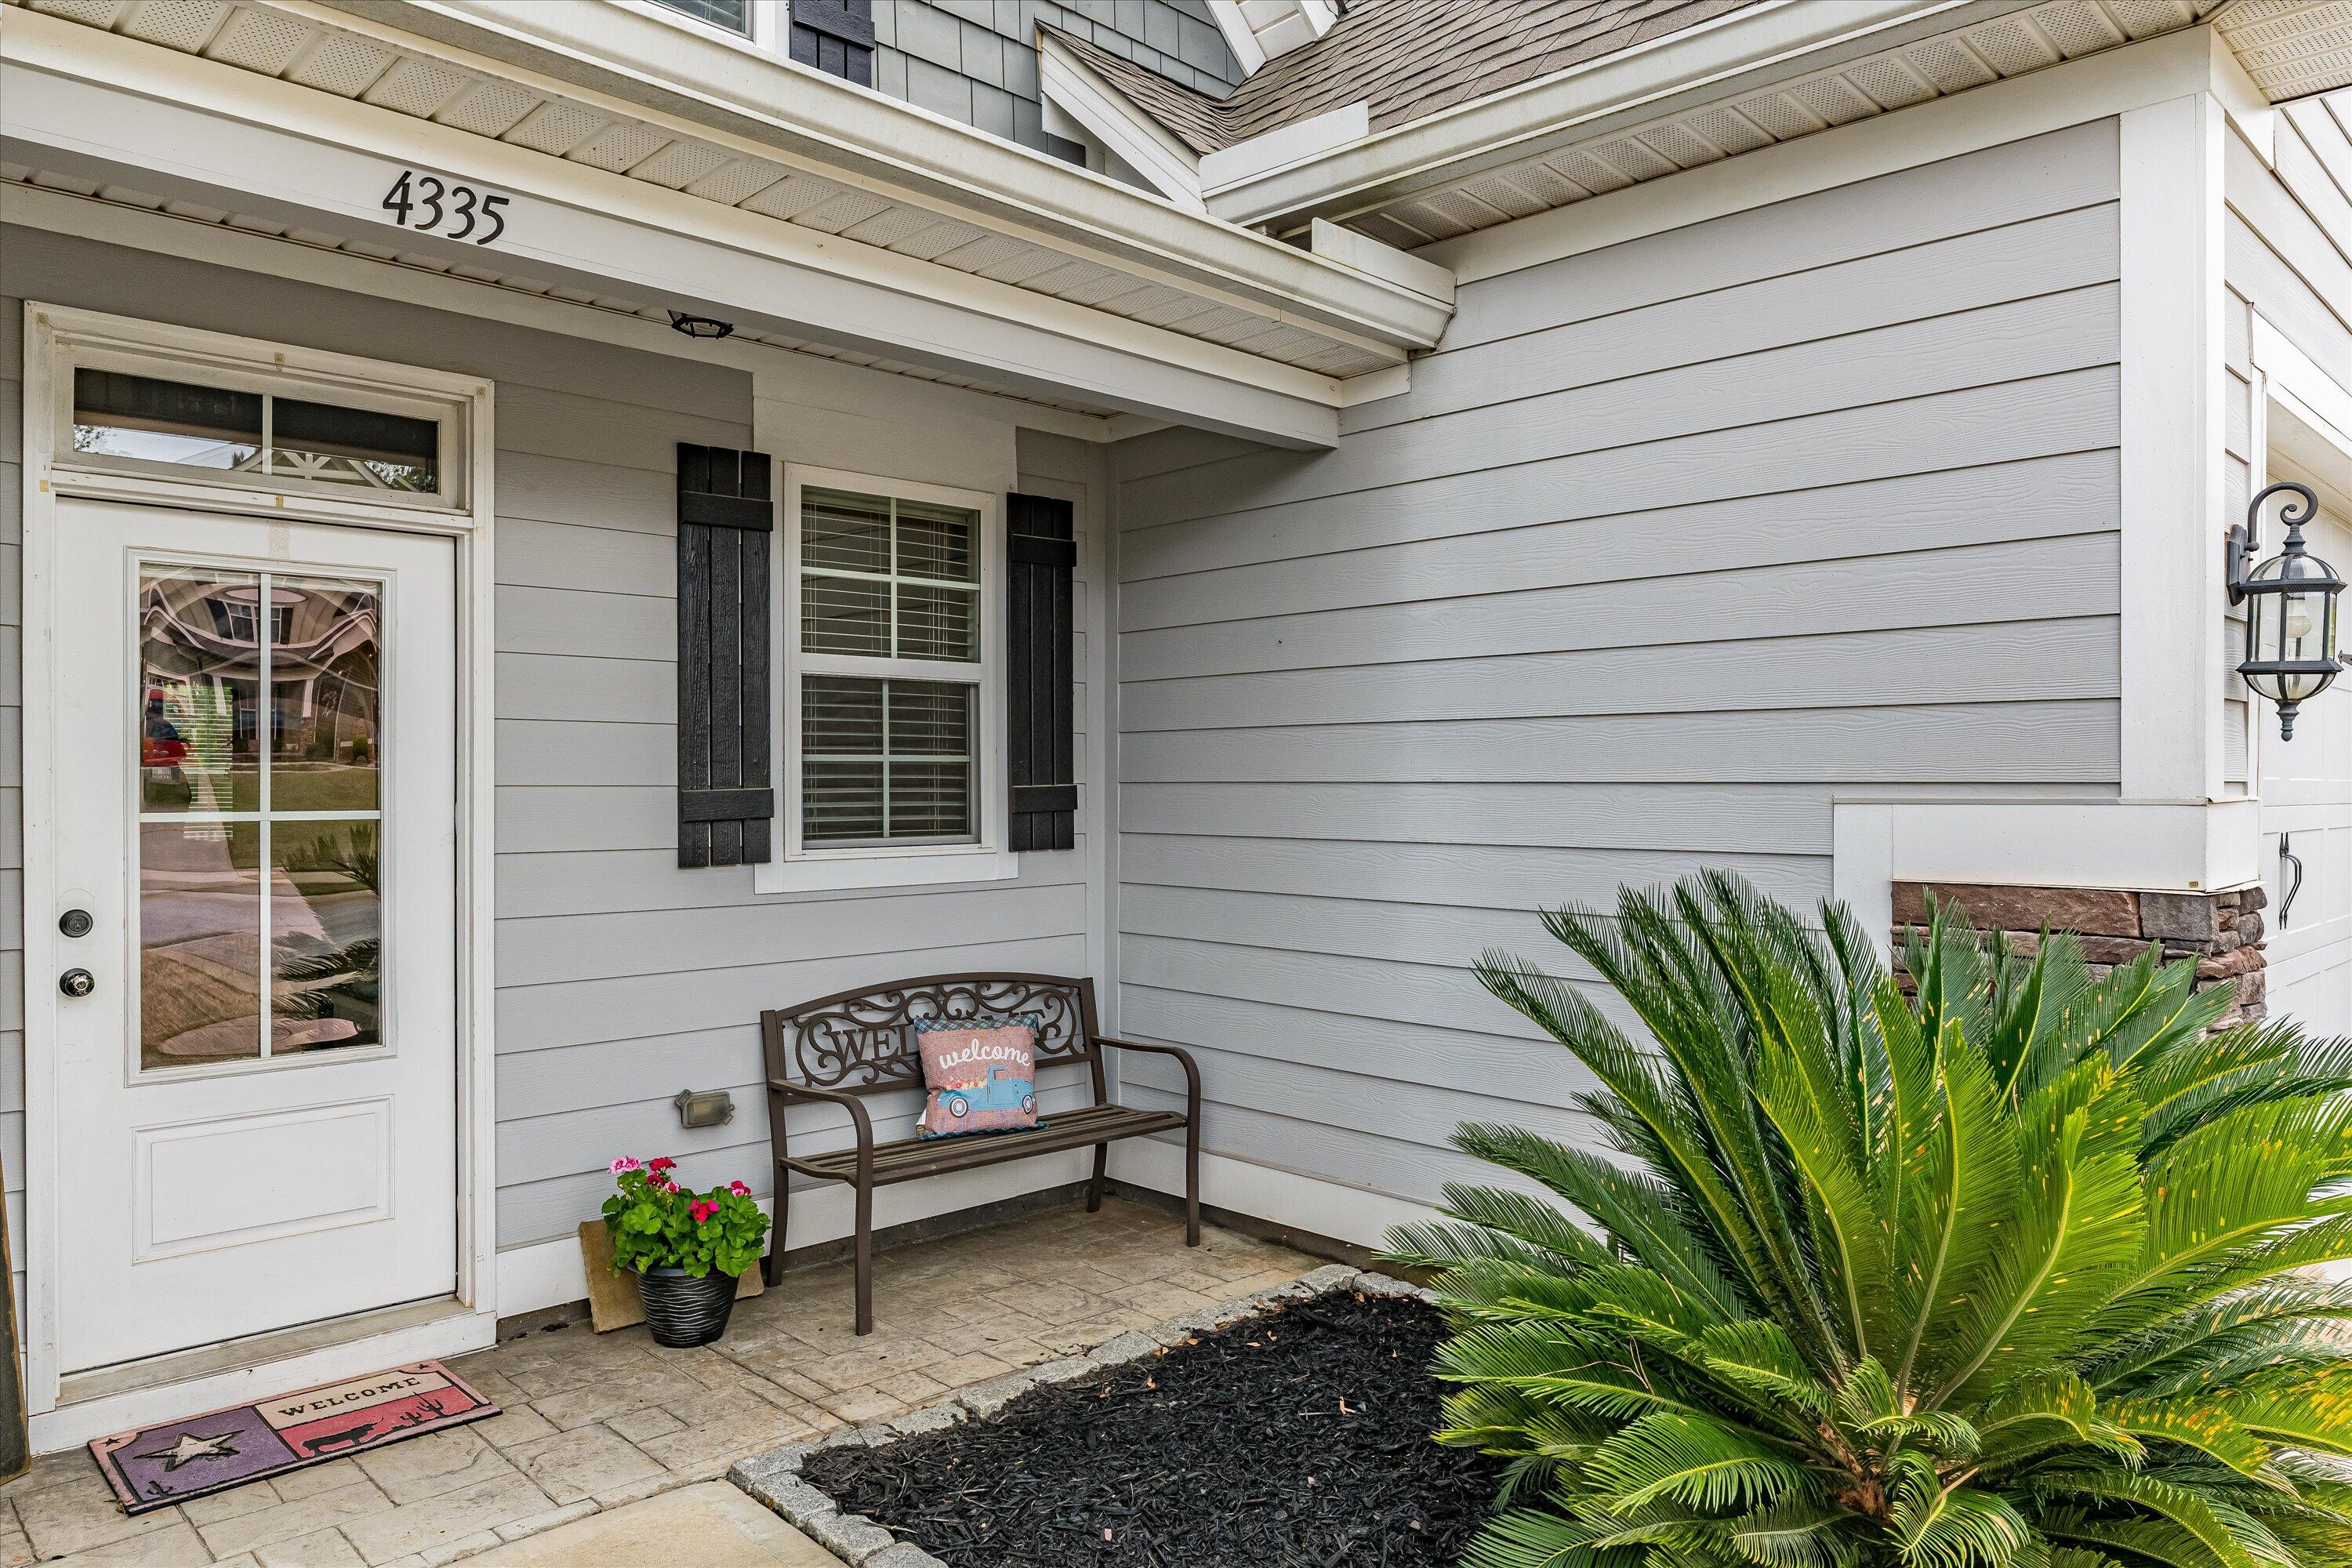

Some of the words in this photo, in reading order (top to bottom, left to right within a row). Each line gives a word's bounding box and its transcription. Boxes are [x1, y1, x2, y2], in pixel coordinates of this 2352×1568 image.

[382, 170, 510, 245] 4335
[938, 1038, 1031, 1067] welcome
[278, 1377, 421, 1416] WELCOME
